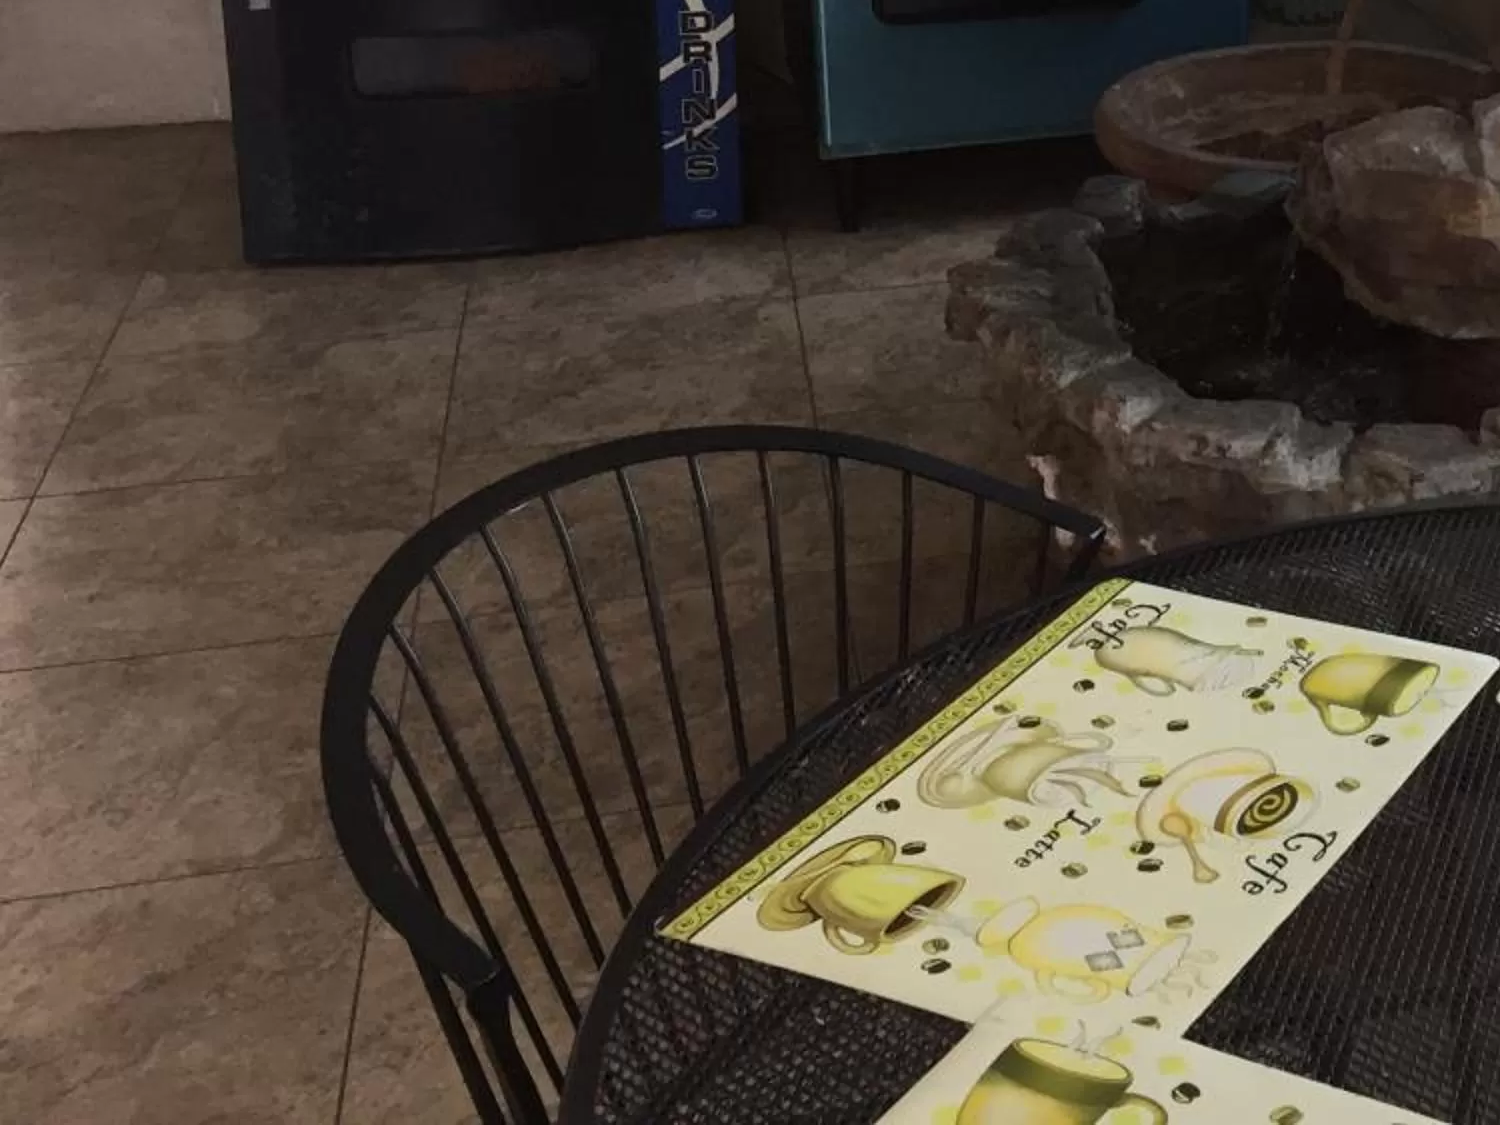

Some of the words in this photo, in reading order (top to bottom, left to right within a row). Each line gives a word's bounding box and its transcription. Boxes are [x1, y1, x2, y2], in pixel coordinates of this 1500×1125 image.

[678, 10, 720, 180] DRINKS
[1084, 602, 1171, 651] Cafe
[1015, 809, 1101, 869] Latte
[1242, 830, 1338, 896] Cafe
